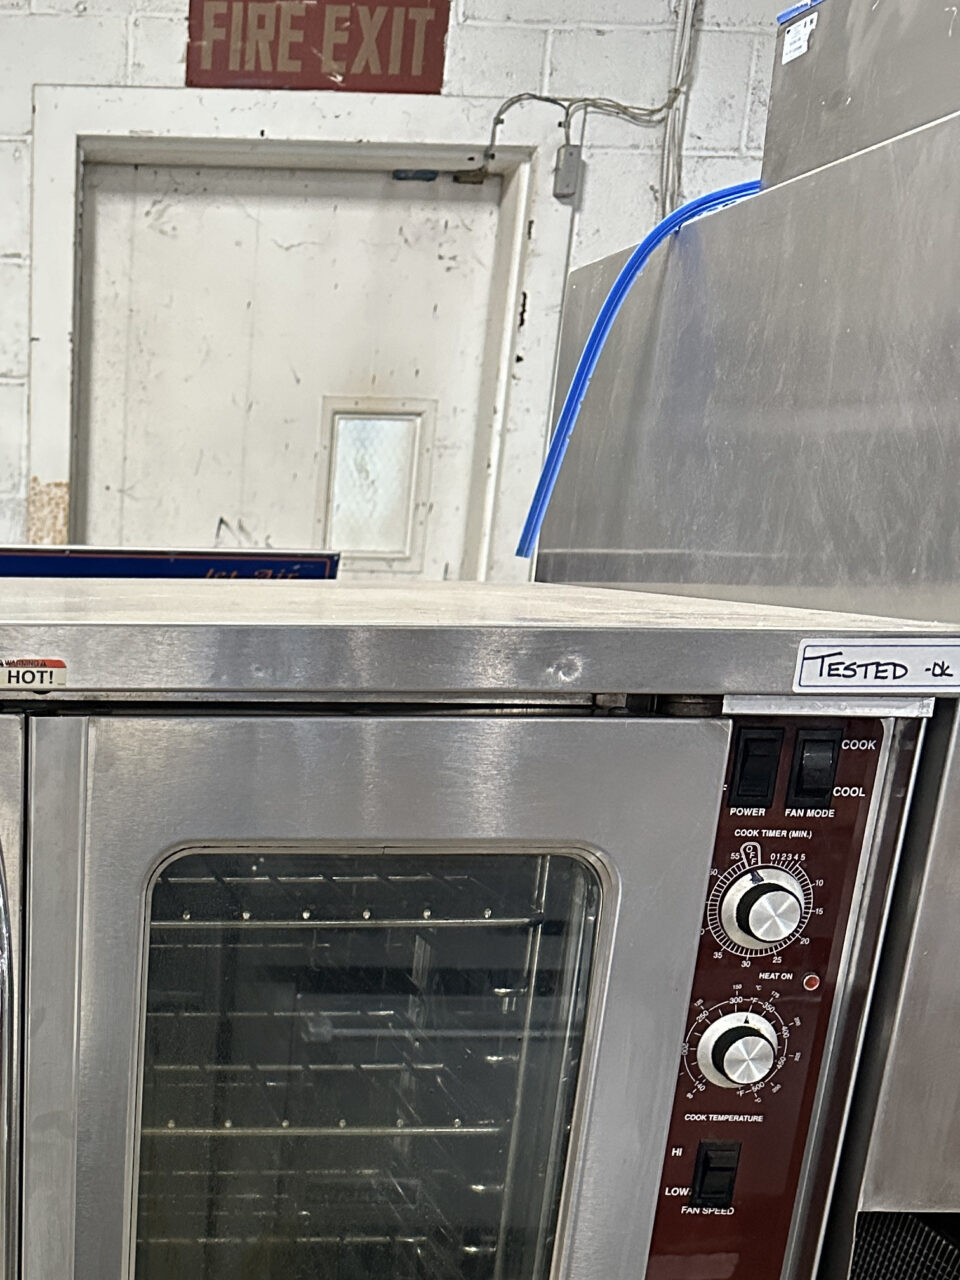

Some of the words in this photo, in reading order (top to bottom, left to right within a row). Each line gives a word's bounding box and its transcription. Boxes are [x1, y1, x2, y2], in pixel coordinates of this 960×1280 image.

[200, 0, 307, 72] FIRE
[321, 5, 436, 76] EXIT
[803, 651, 909, 680] TESTED
[7, 670, 53, 684] HOT!
[841, 740, 877, 750] COOK
[832, 786, 866, 797] COOL
[729, 808, 766, 817] POWER
[784, 808, 804, 817] FAN
[806, 809, 836, 818] MODE
[734, 829, 760, 837] COOK
[761, 829, 787, 838] TIMER
[788, 830, 813, 839] (MIN.)
[800, 937, 810, 945] 20
[713, 951, 723, 959] 35
[741, 960, 751, 968] 30
[758, 972, 779, 980] HEAT
[762, 1001, 775, 1013] 350
[708, 1114, 764, 1122] TEMPERATURE
[671, 1147, 683, 1157] HI
[665, 1187, 690, 1196] LOW
[681, 1206, 700, 1214] FAN
[702, 1207, 735, 1215] SPEED
